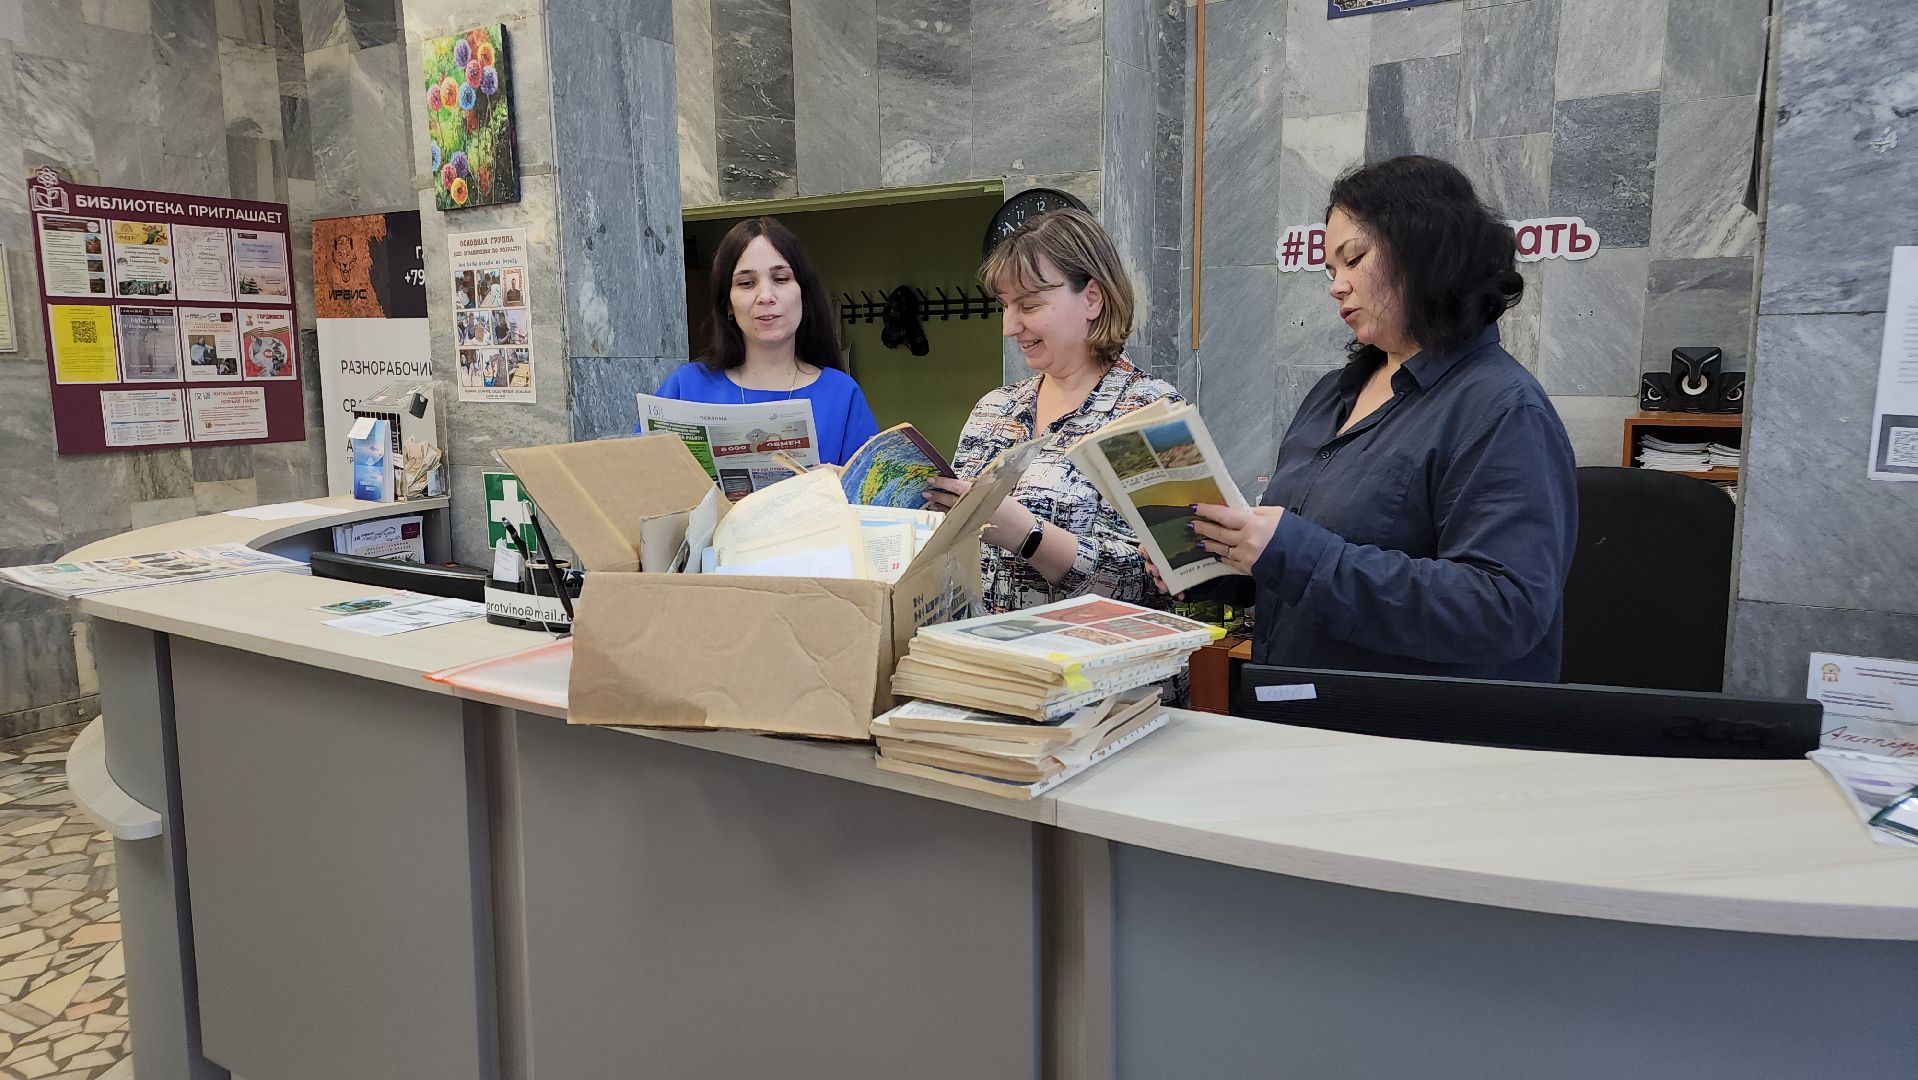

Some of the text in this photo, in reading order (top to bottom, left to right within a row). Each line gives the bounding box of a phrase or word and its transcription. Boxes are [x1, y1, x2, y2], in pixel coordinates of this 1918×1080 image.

[75, 194, 283, 224] БИБЛИОТЕКА ПРИГЛАШАЕТ
[1036, 201, 1046, 212] 12
[1016, 210, 1025, 220] 11
